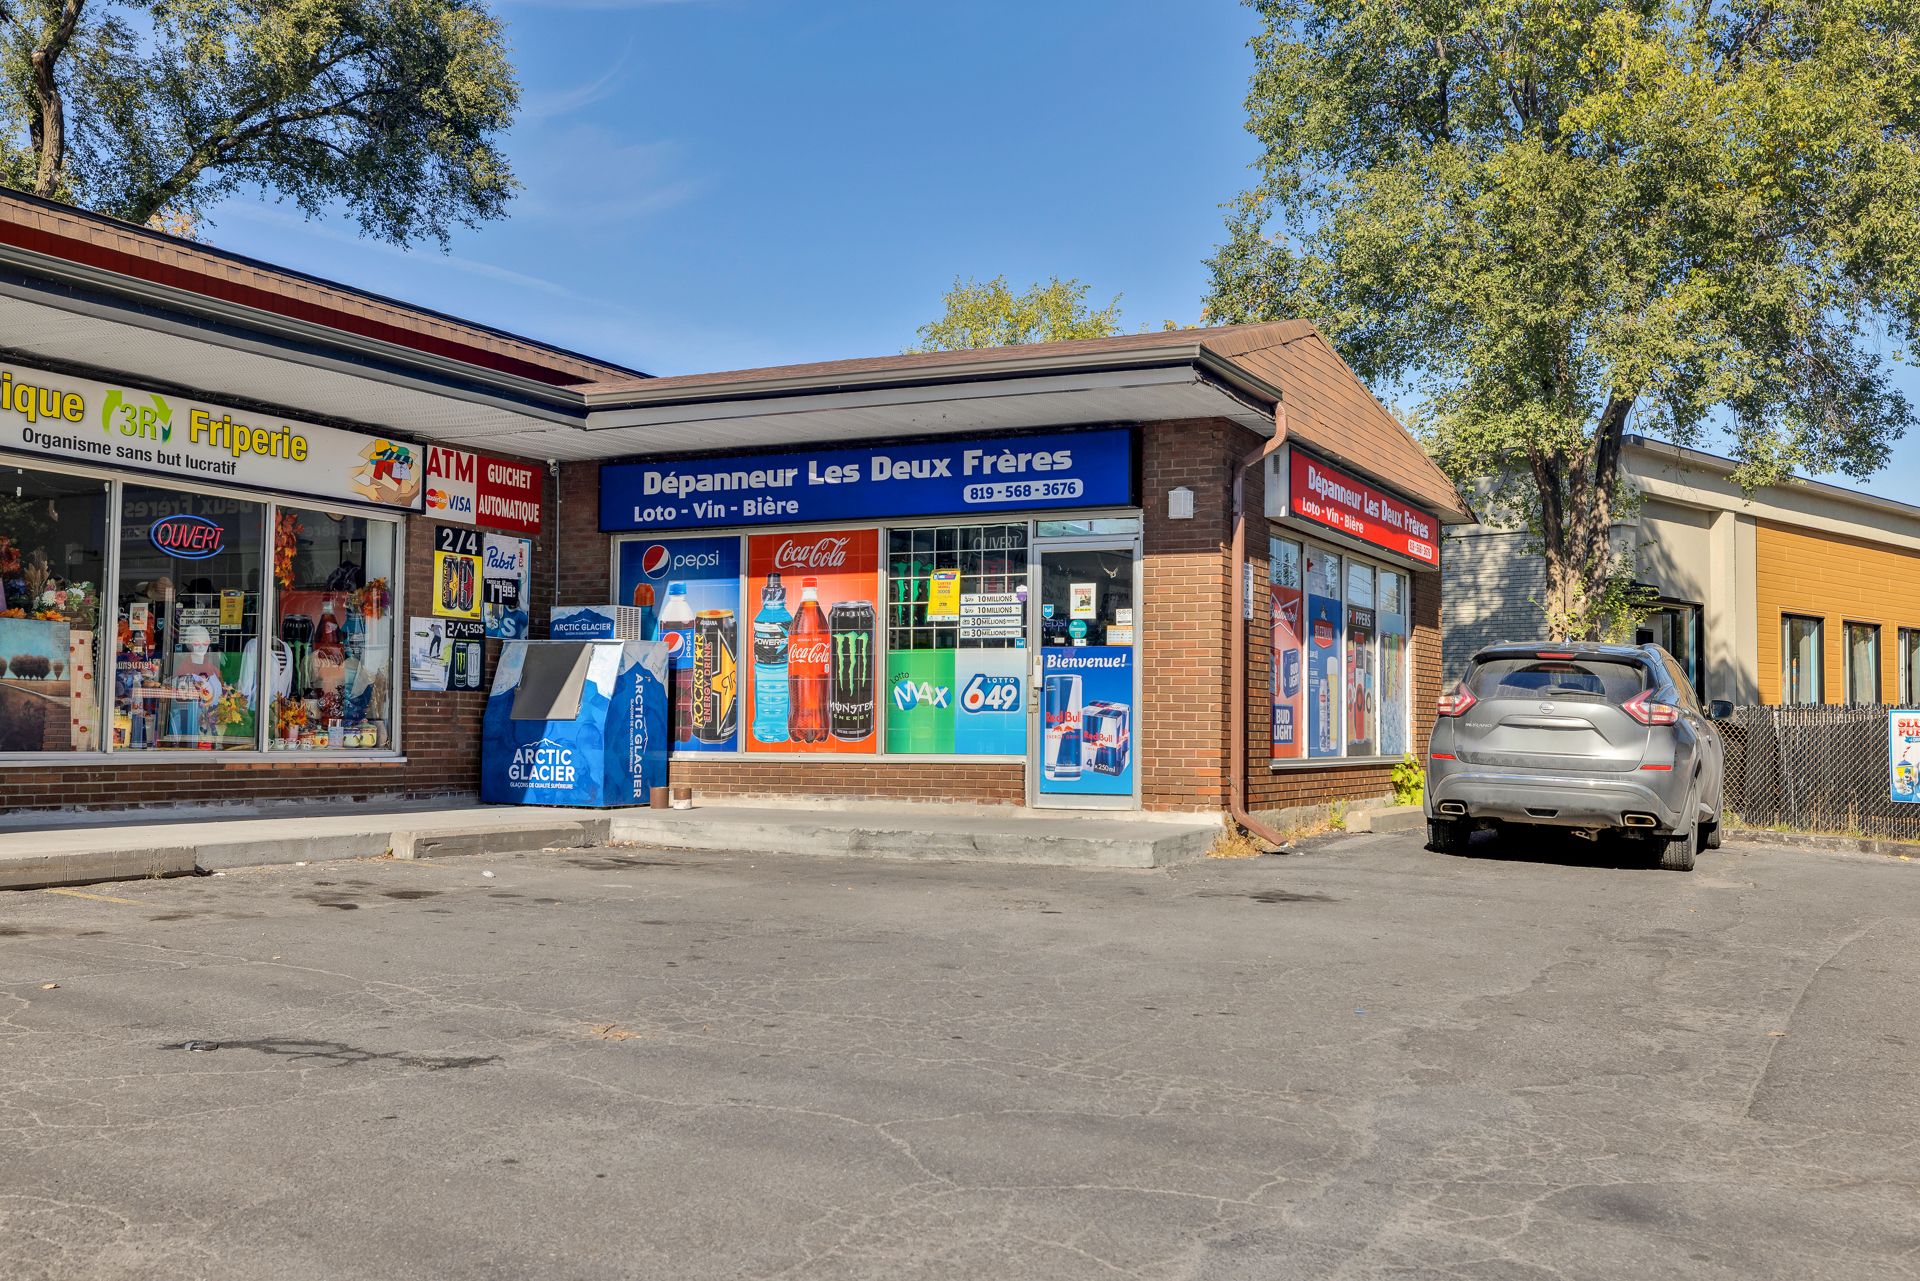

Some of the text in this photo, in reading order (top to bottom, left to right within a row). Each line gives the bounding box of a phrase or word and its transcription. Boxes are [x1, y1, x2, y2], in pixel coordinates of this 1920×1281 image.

[0, 371, 308, 462] ique 3R Friperie
[22, 427, 237, 476] Organisme sans but lucratif
[426, 446, 474, 484] ATM
[487, 463, 532, 490] GUICHET
[643, 448, 1073, 499] Dépanneur Les Deux Frères
[448, 495, 471, 513] VISA
[478, 494, 540, 526] AUTOMATIQUE
[634, 505, 677, 523] Loto
[693, 499, 726, 519] Vin
[743, 496, 799, 517] Bière
[1308, 465, 1429, 540] Dépanneur Les Deux Frères
[1302, 496, 1321, 517] Loto
[1326, 506, 1339, 525] Vin
[1344, 514, 1364, 534] Bière
[157, 523, 225, 549] OUVERT
[486, 545, 516, 571] Pabst
[674, 550, 719, 571] pepsi
[774, 536, 851, 569] Coca-Cola
[554, 623, 611, 631] ARCTIC GLACIER
[789, 642, 830, 664] Coca-Cola
[1046, 653, 1127, 668] Bienvenue!
[703, 641, 711, 721] ENERGY DRINK
[830, 700, 874, 714] MONSTER
[833, 713, 870, 721] ENERGY
[1046, 711, 1063, 723] Red
[1275, 709, 1290, 724] BUD
[633, 673, 644, 798] ARCTIC GLACIER
[1083, 731, 1099, 741] Red
[1099, 733, 1113, 743] Bull
[1273, 725, 1293, 741] LIGHT
[512, 748, 572, 765] ARCTIC
[1086, 758, 1093, 768] 4
[508, 764, 575, 782] GLACIER
